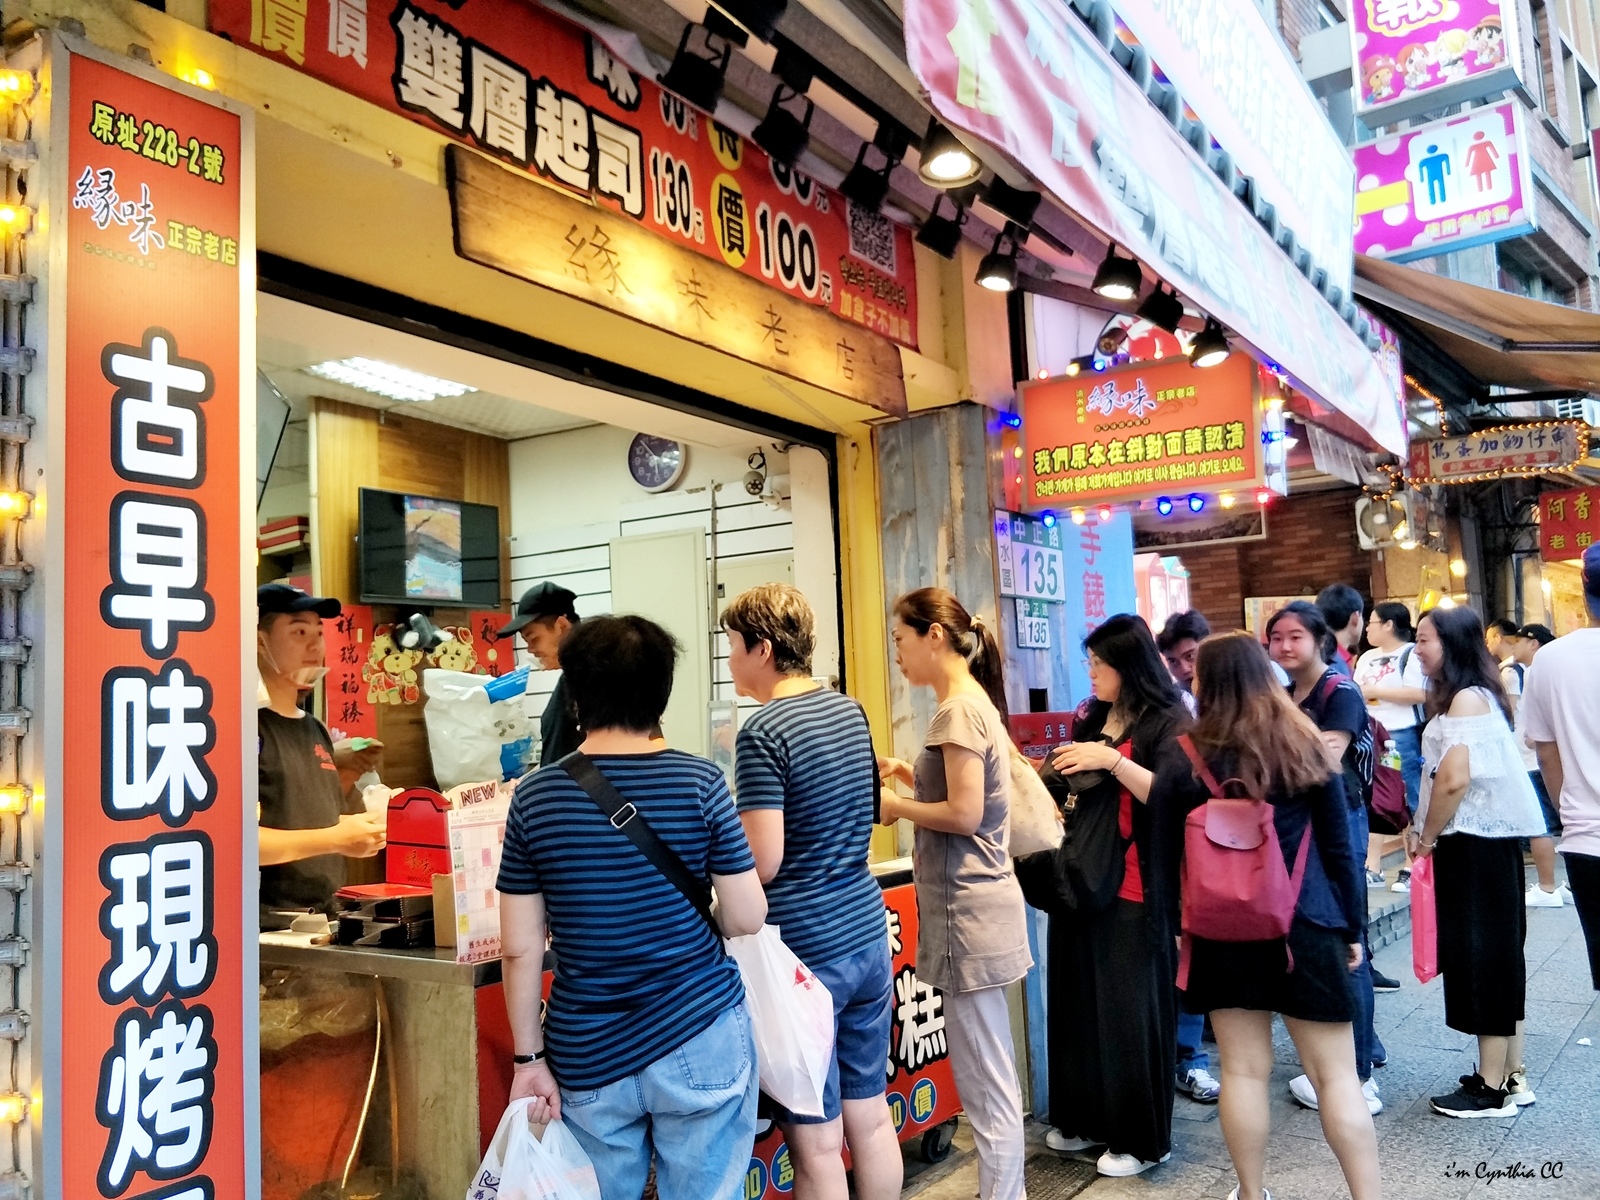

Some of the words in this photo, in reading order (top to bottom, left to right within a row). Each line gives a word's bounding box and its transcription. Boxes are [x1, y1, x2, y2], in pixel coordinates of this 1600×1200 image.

[395, 5, 643, 218] 雙層起司
[89, 100, 226, 185] 原址228-2號
[650, 146, 706, 244] 130元
[167, 221, 237, 266] 正宗老店
[755, 203, 833, 300] 100元
[563, 223, 857, 382] 緣味老店
[1156, 385, 1196, 402] 正宗老店
[1033, 421, 1246, 476] 我們原本在斜對面請認清
[1547, 491, 1592, 521] 阿香
[996, 517, 1012, 588] 淡水區
[1014, 517, 1059, 548] 中正路
[1548, 531, 1594, 550] 老街
[1021, 548, 1058, 596] 135
[1080, 520, 1107, 634] 手錶
[1024, 602, 1049, 617] 中正路
[1028, 621, 1047, 644] 135
[1044, 722, 1067, 739] 公告
[104, 330, 212, 1200] 古早味現烤
[460, 782, 497, 807] NEW
